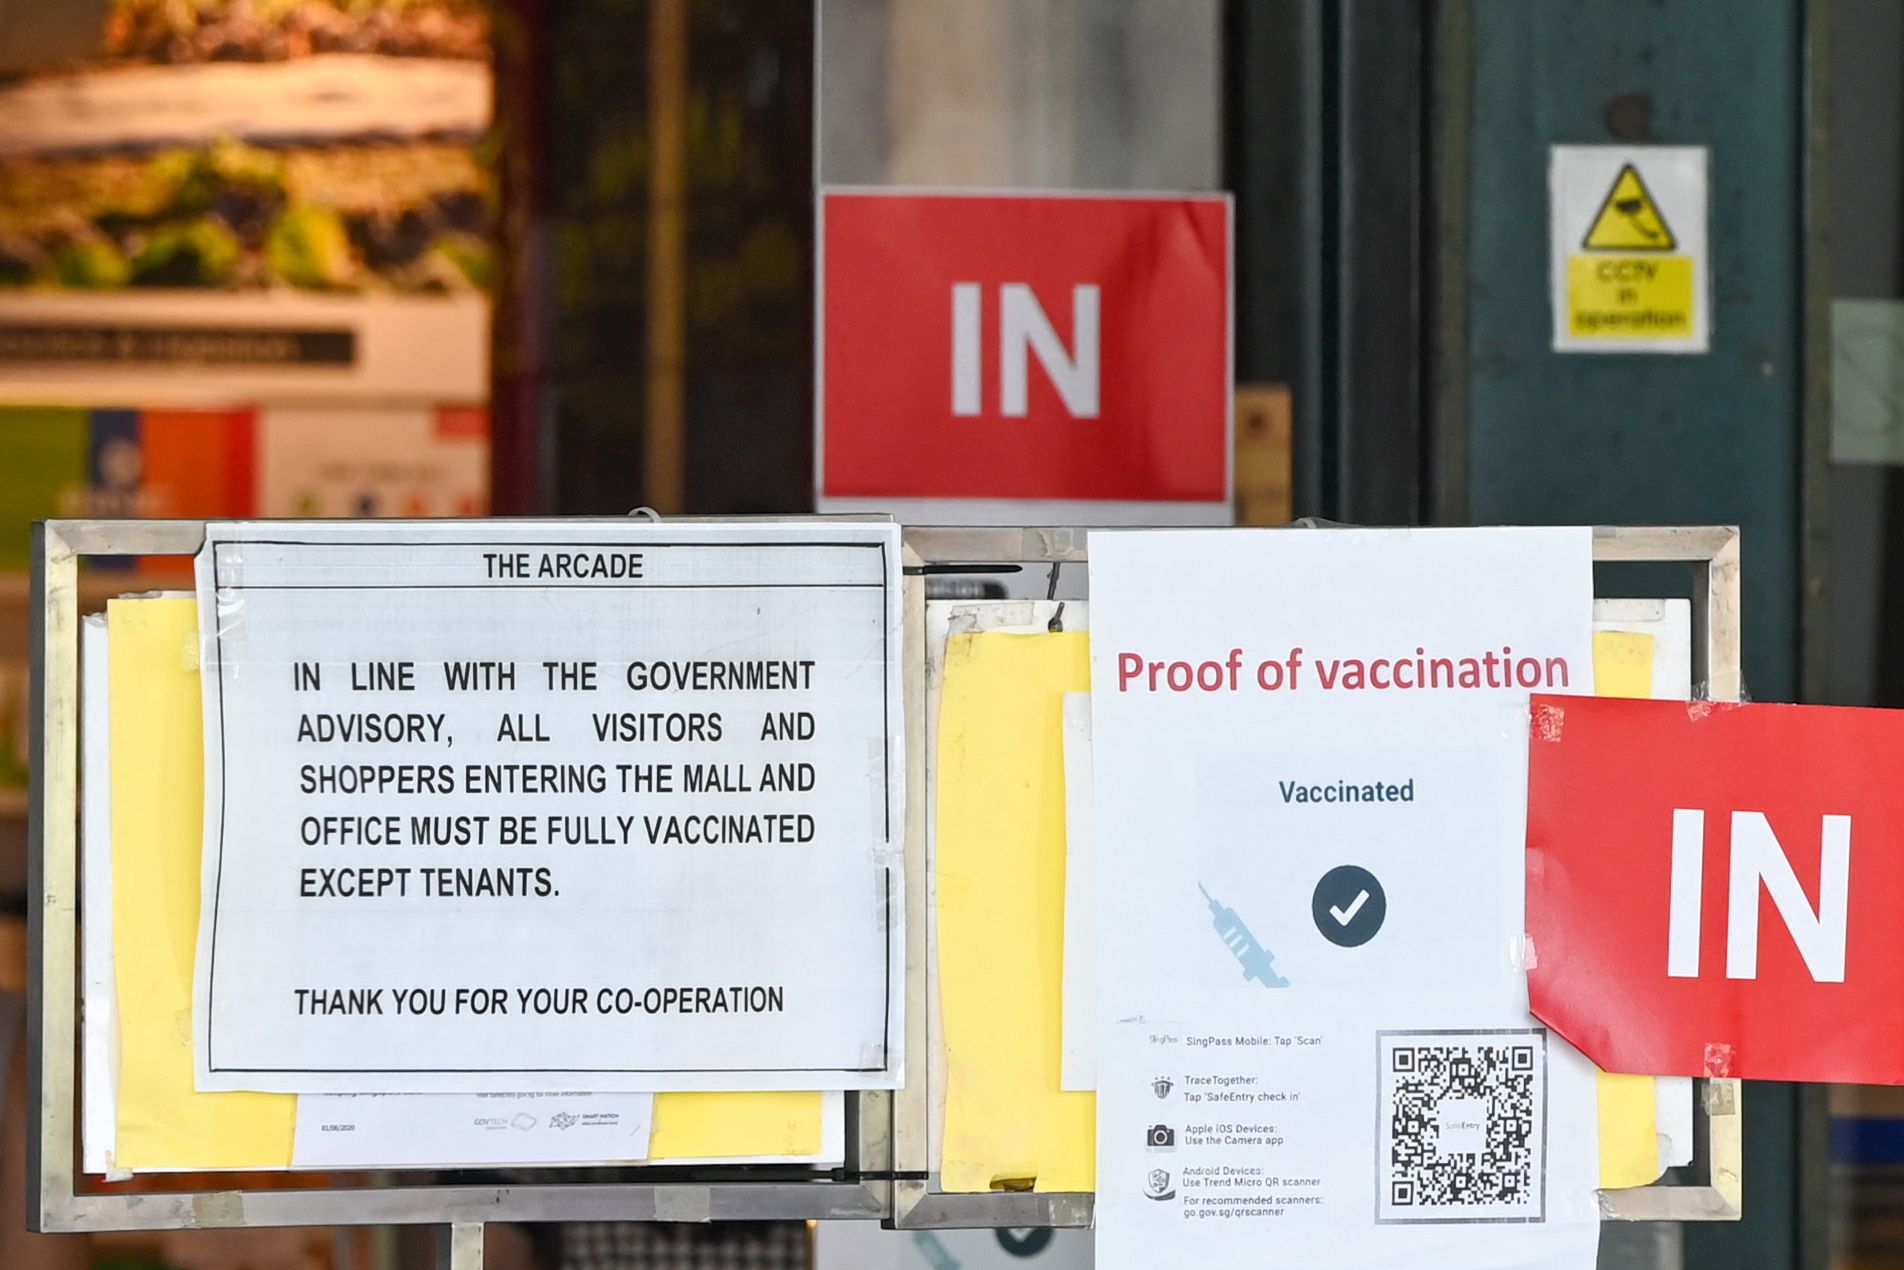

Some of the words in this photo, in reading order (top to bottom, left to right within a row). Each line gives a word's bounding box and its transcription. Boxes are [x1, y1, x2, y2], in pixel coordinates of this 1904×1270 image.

[1597, 260, 1657, 281] CCTV
[951, 283, 1100, 417] IN
[483, 554, 530, 578] THE
[538, 553, 644, 579] ARCADE
[294, 662, 320, 691] IN
[352, 662, 415, 690] LINE
[444, 662, 514, 690] WITH
[543, 662, 597, 690] THE
[627, 661, 815, 690] GOVERNMENT
[1119, 649, 1242, 692] Proof
[1257, 648, 1302, 690] of
[1315, 646, 1568, 689] vaccination
[298, 714, 452, 747] ADVISORY,
[497, 714, 550, 741] ALL
[593, 713, 722, 742] VISITORS
[761, 712, 815, 741] AND
[301, 765, 454, 794] SHOPPERS
[466, 765, 606, 793] ENTERING
[616, 765, 672, 792] THE
[684, 764, 751, 792] MALL
[759, 763, 815, 791] AND
[1278, 778, 1415, 804] Vaccinated
[301, 816, 401, 845] OFFICE
[411, 816, 489, 845] MUST
[500, 816, 537, 844] BE
[548, 816, 634, 844] FULLY
[644, 815, 814, 844] VACCINATED
[300, 868, 411, 897] EXCEPT
[420, 868, 559, 897] TENANTS.
[1667, 808, 1852, 983] IN
[295, 989, 383, 1015] THANK
[392, 989, 445, 1015] YOU
[456, 988, 508, 1014] FOR
[517, 988, 588, 1014] YOUR
[597, 986, 783, 1014] CO-OPERATION
[1185, 1035, 1234, 1048] SingPass
[1234, 1035, 1272, 1047] Mobile:
[1273, 1035, 1292, 1047] Tap
[1294, 1035, 1324, 1046] 'Scan'
[1184, 1123, 1214, 1137] Apple
[1215, 1123, 1233, 1134] iOS
[1235, 1123, 1277, 1134] Devices:
[1184, 1135, 1205, 1146] Use
[1205, 1135, 1223, 1146] the
[1224, 1135, 1263, 1145] Camera
[1265, 1136, 1284, 1147] app
[1182, 1166, 1220, 1176] Android
[1222, 1166, 1265, 1176] Devices:
[1182, 1178, 1201, 1188] Use
[1203, 1177, 1232, 1187] Trend
[1234, 1177, 1263, 1187] Micro
[1264, 1176, 1280, 1188] QR
[1282, 1178, 1321, 1187] scanner
[1183, 1194, 1201, 1207] For
[1201, 1195, 1273, 1206] recommended
[1275, 1196, 1324, 1205] scanners:
